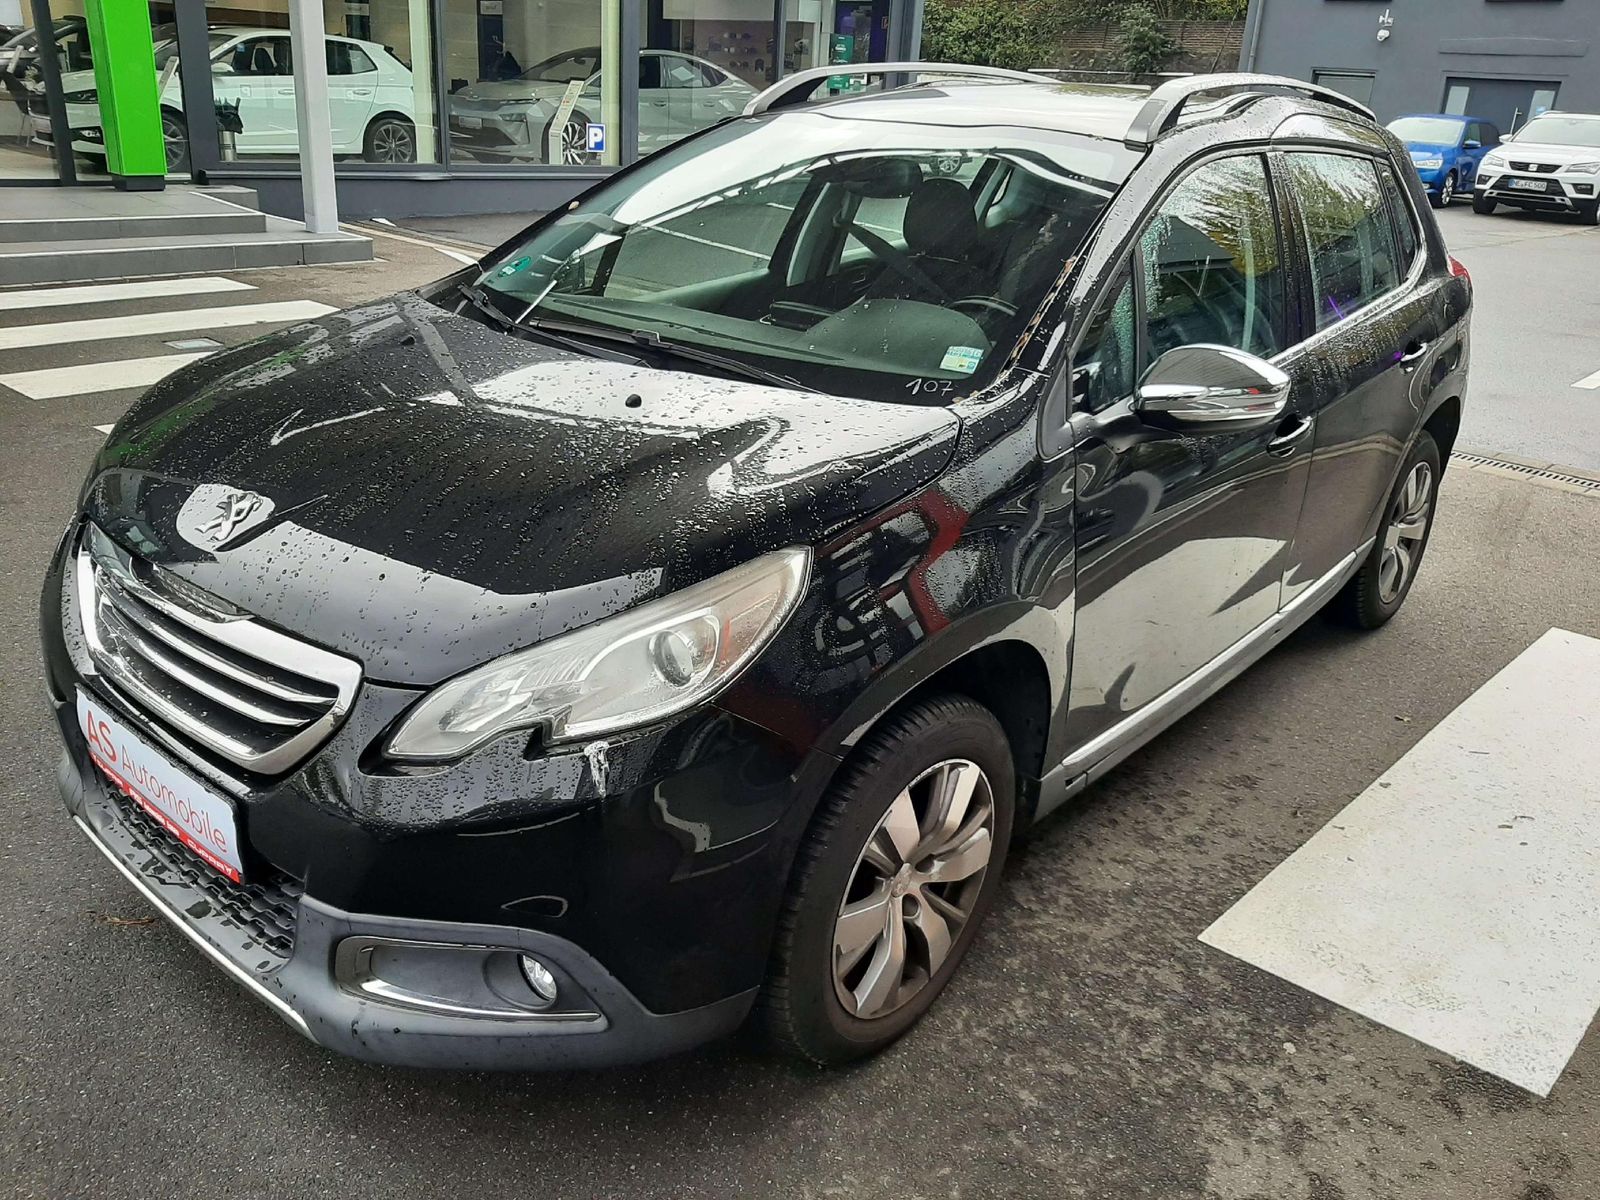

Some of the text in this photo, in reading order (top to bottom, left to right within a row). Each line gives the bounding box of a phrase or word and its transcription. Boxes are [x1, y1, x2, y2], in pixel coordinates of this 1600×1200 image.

[589, 127, 603, 148] P
[905, 378, 953, 397] 107
[87, 710, 117, 762] AS
[121, 745, 228, 853] Automobile
